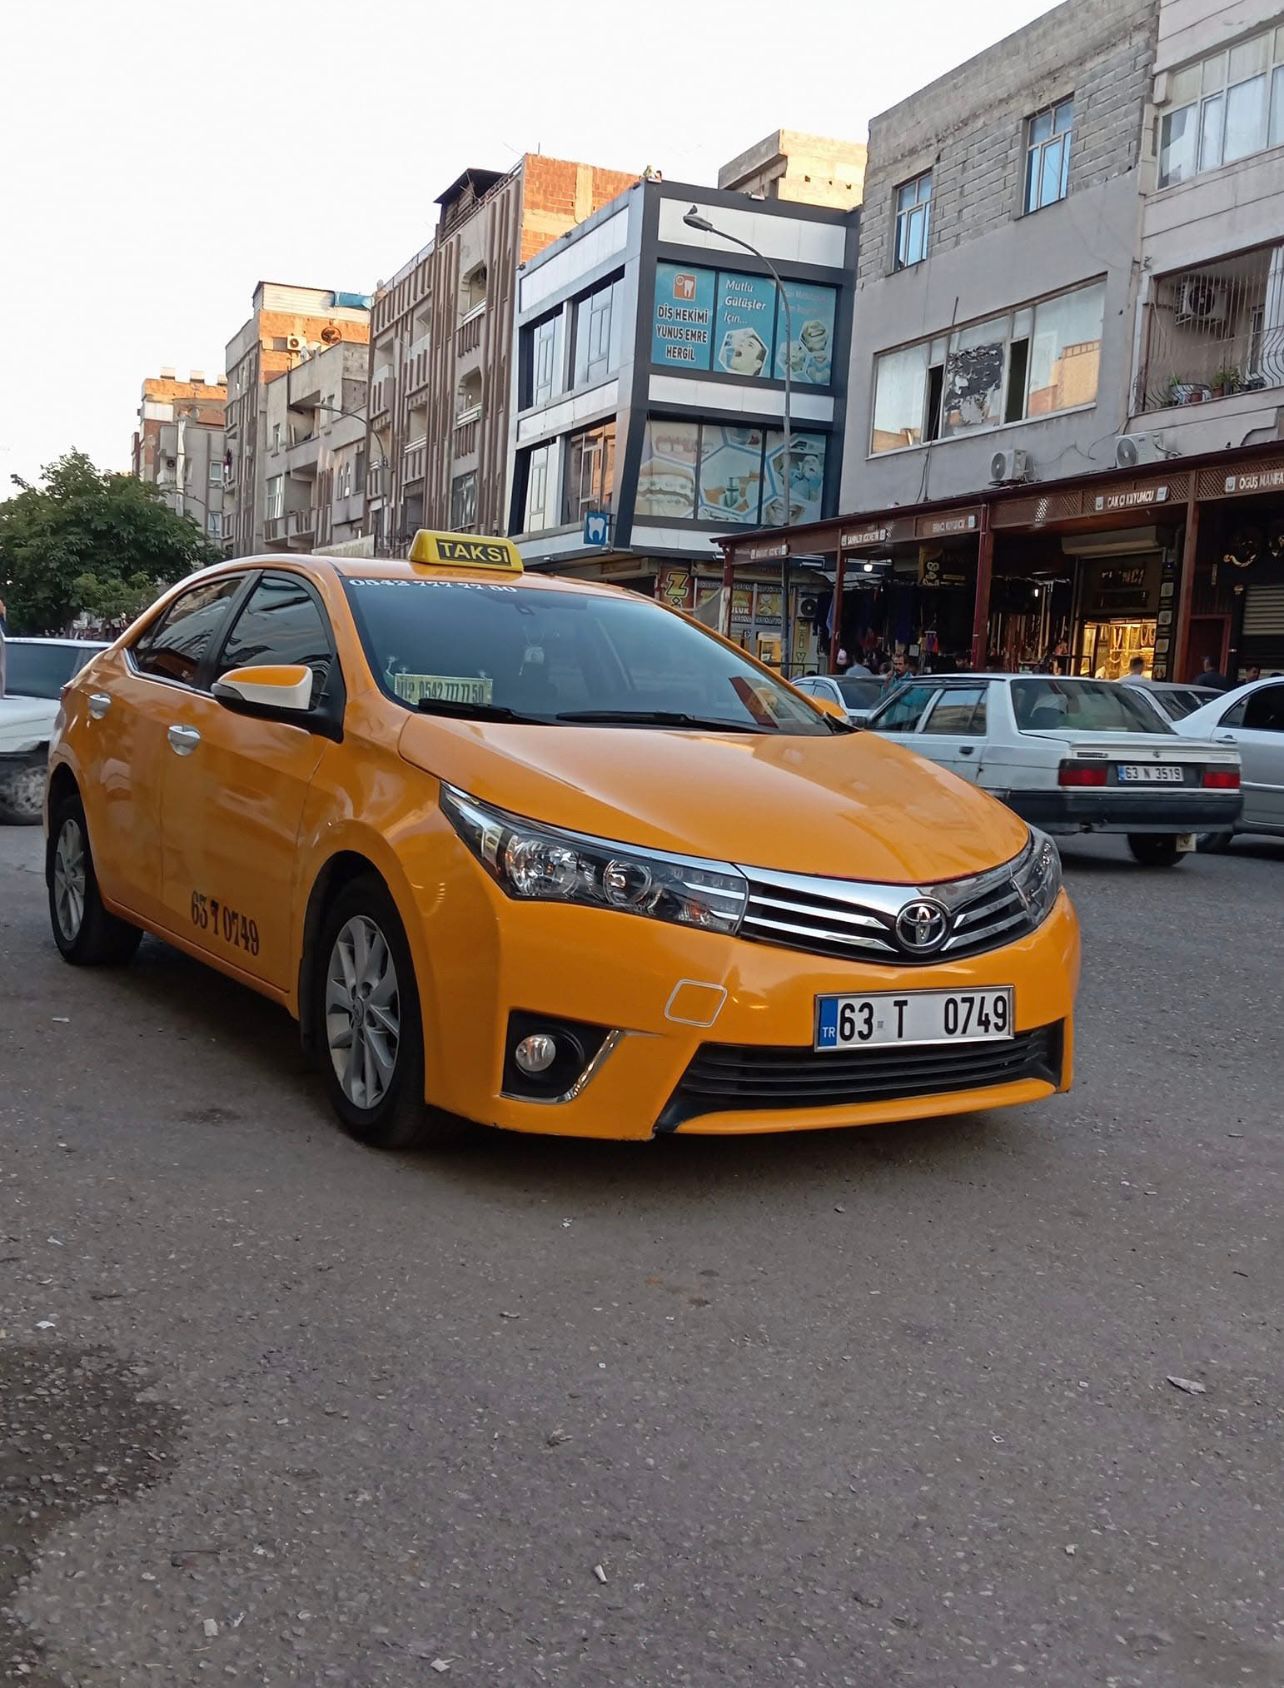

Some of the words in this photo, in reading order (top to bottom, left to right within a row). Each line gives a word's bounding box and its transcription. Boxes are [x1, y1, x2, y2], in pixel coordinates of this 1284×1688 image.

[725, 279, 754, 293] Mutlu
[724, 295, 767, 311] Gülüşler
[657, 302, 674, 322] DİŞ
[675, 306, 709, 325] HEKİMİ
[656, 324, 684, 341] YUNUS
[684, 328, 708, 344] EMRE
[666, 345, 696, 362] HERGİL
[349, 579, 410, 587] 0542
[457, 582, 483, 590] 77
[488, 585, 517, 593] 50
[1125, 766, 1139, 779] 63
[191, 890, 208, 929] 63
[210, 898, 219, 936] T
[223, 906, 259, 956] 0749
[822, 1026, 836, 1039] TR
[839, 1001, 874, 1042] 63
[893, 999, 909, 1039] T
[943, 994, 1008, 1036] 0749
